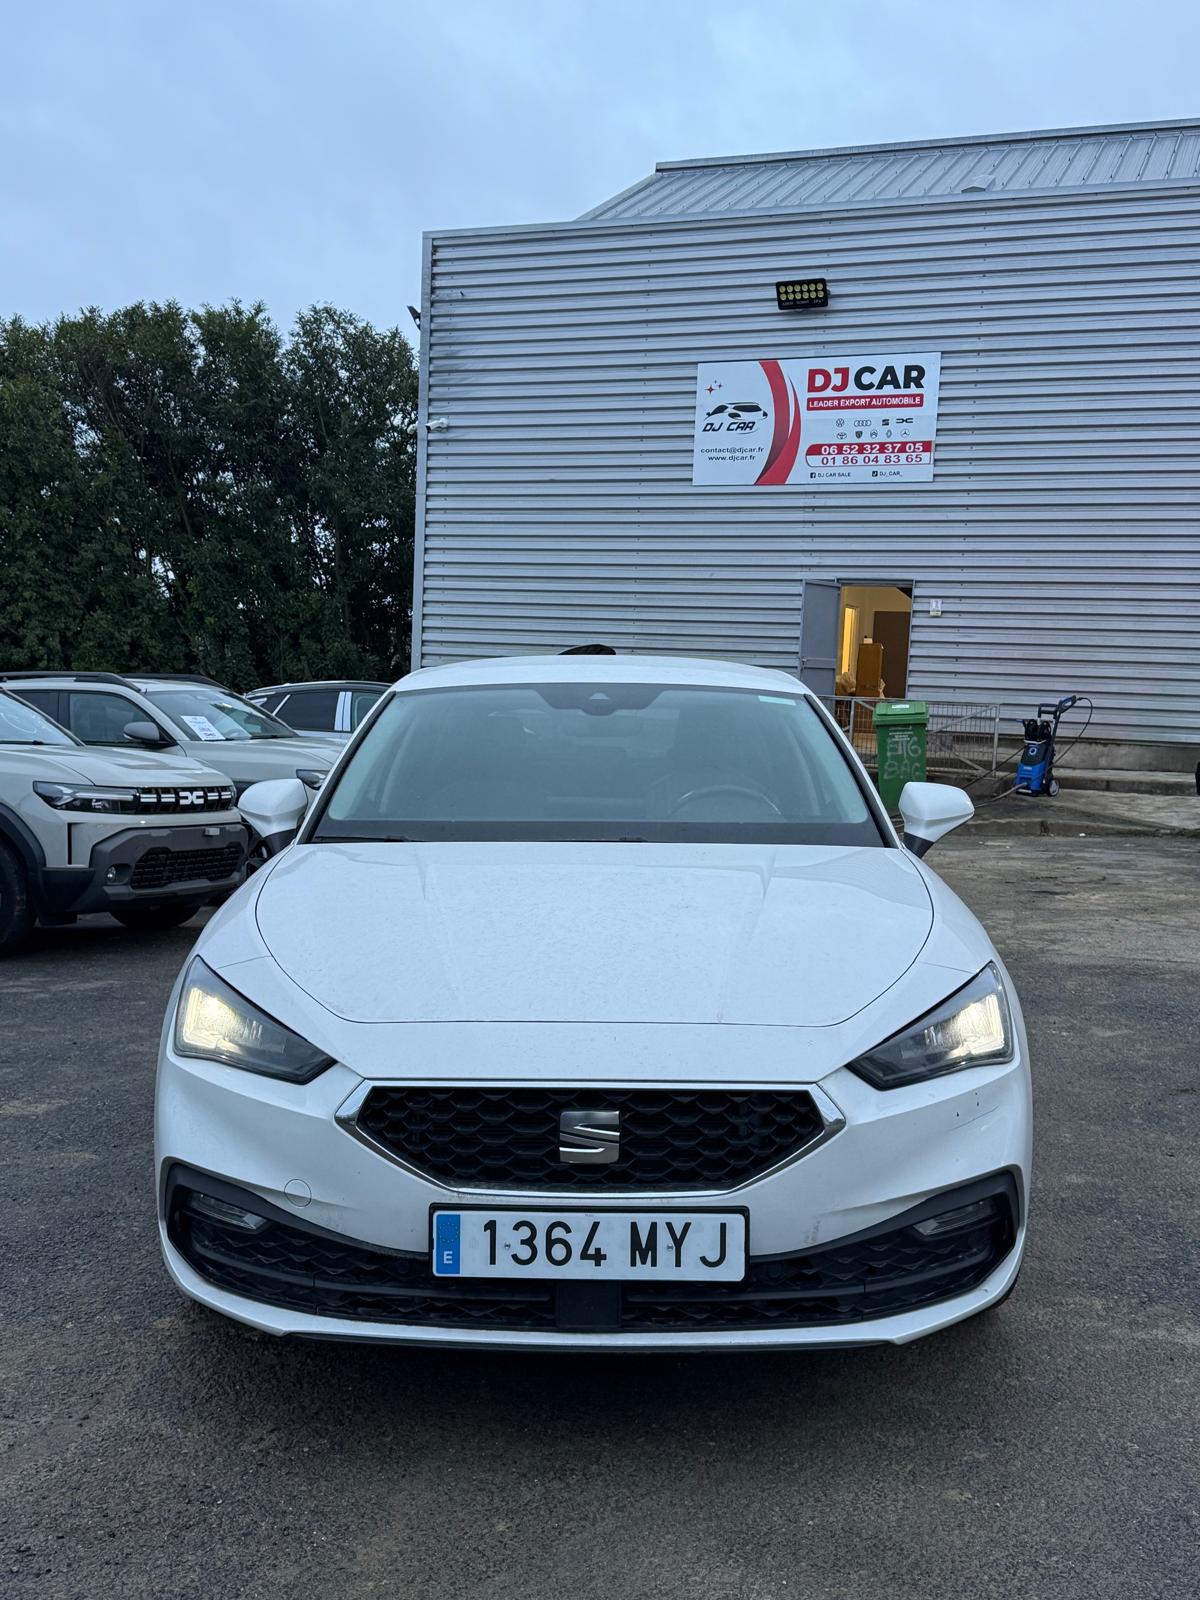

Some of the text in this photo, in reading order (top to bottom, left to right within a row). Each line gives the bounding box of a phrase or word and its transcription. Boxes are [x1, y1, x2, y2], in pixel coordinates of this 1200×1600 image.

[809, 396, 921, 408] LEADER EXPORT AUTOMOBILE
[702, 421, 756, 432] DJ CAR
[700, 446, 764, 454] contact@djcar.fr
[821, 442, 924, 455] 06 52 32 37 05
[821, 453, 923, 466] 01 86 04 83 65
[483, 1219, 728, 1269] 1364 MYJ
[443, 1251, 453, 1264] E
